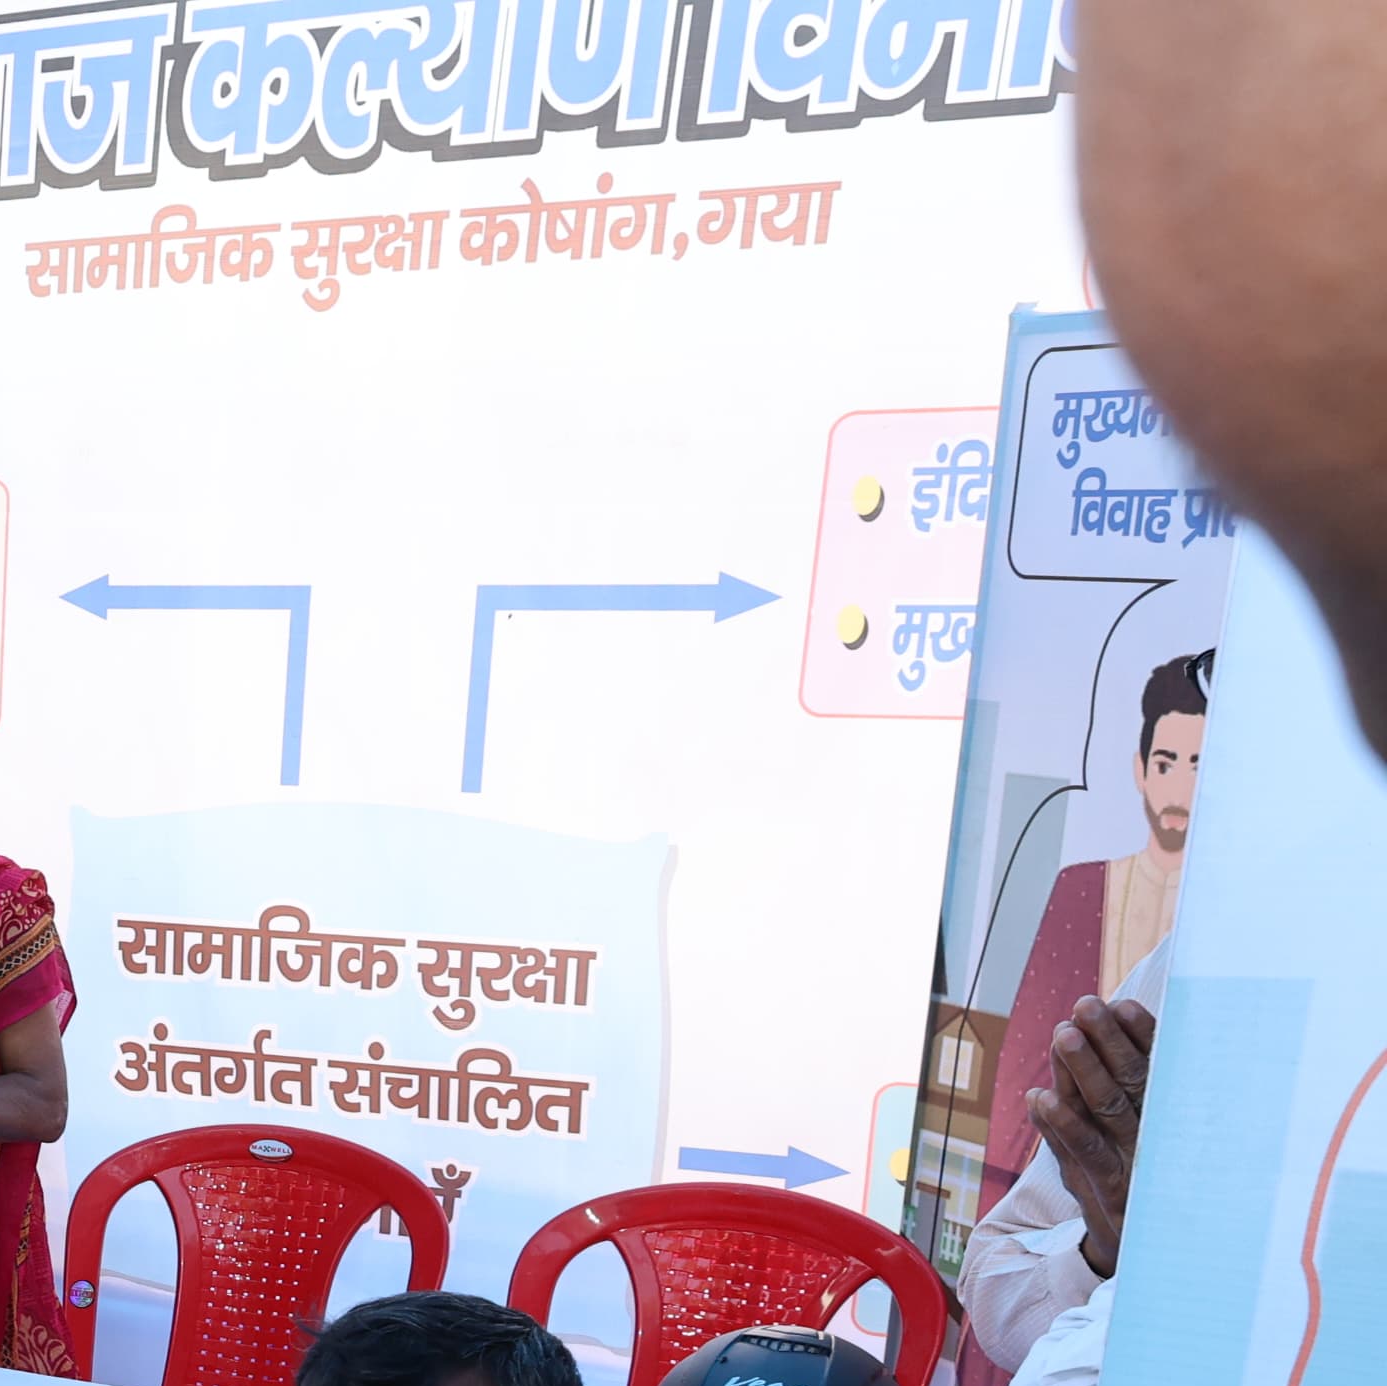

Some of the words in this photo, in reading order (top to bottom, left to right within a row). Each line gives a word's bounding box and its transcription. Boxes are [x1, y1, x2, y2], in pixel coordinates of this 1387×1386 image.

[25, 204, 282, 297] सामाजिक
[290, 208, 450, 312] सुरक्षा
[1071, 467, 1178, 543] विवाह
[117, 904, 407, 992] सामाजिक
[417, 939, 597, 1031] सुरक्षा
[114, 1023, 315, 1109] अंतर्गत
[328, 1041, 590, 1136] संचालित
[251, 1144, 291, 1154] MAXWELL
